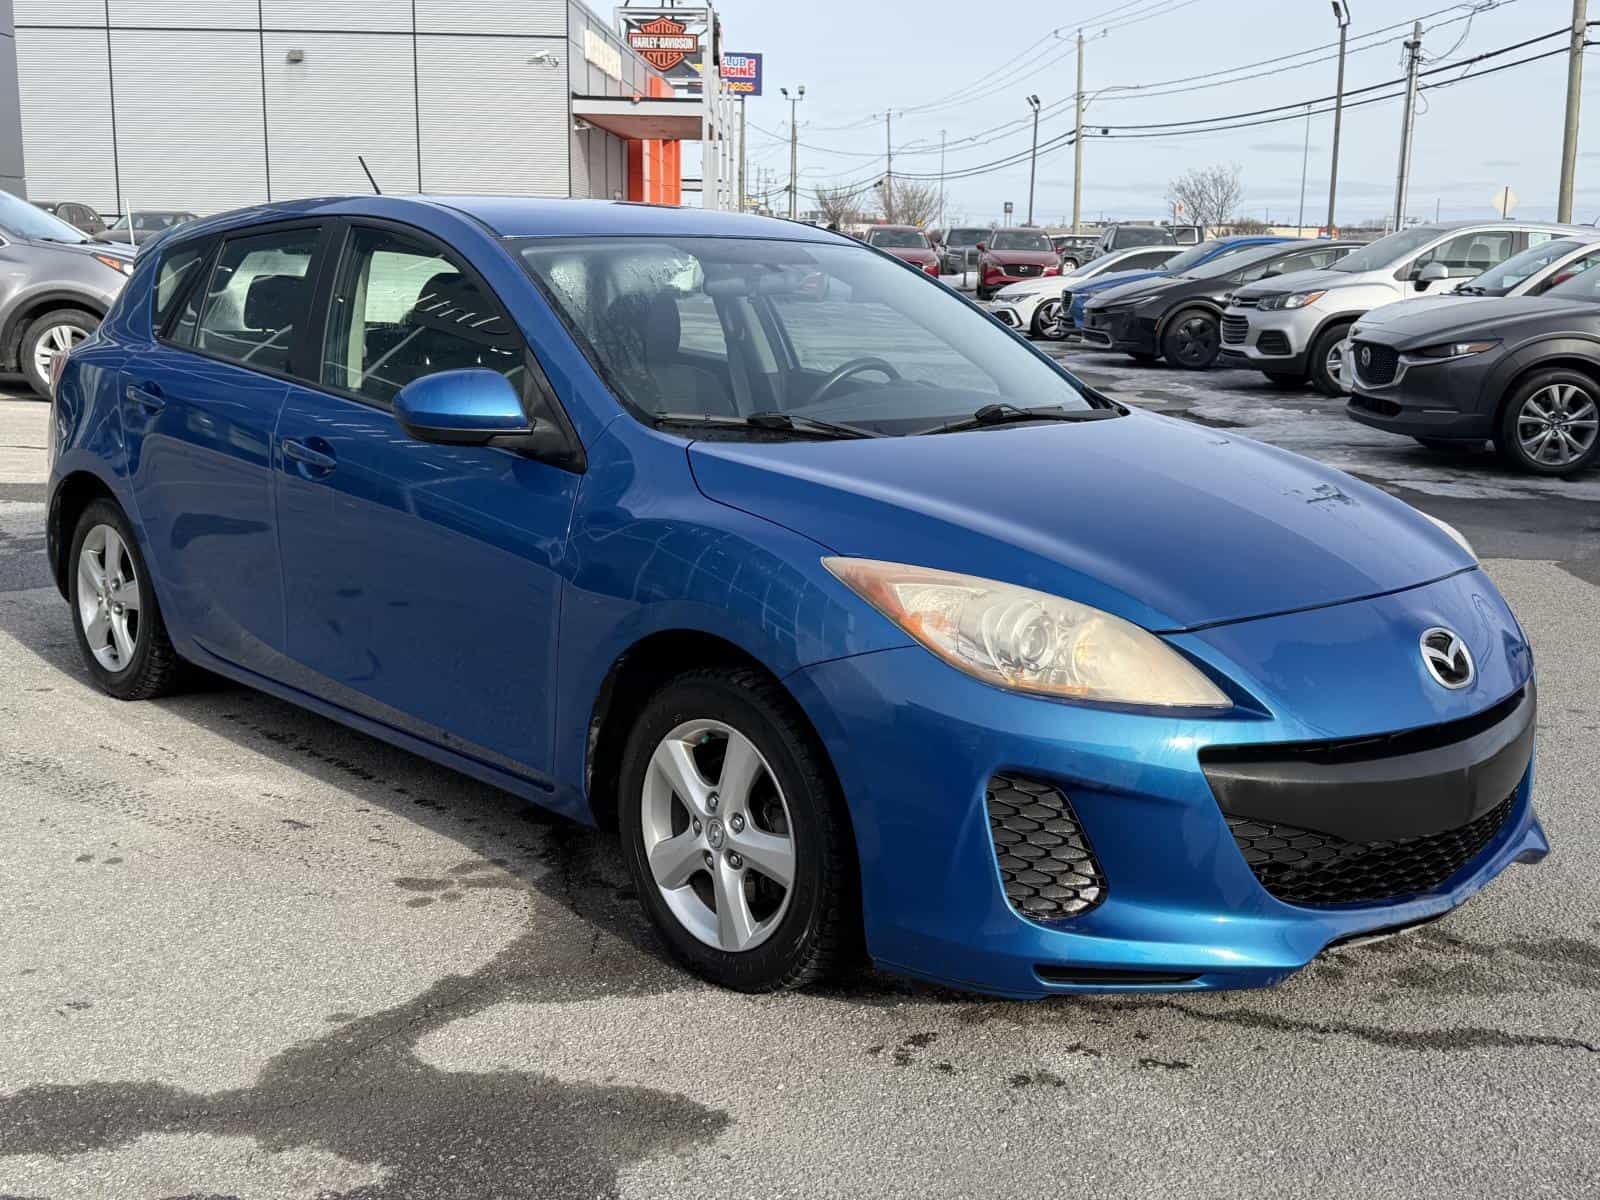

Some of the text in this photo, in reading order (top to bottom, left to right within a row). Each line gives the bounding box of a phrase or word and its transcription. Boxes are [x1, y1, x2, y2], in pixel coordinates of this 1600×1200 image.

[646, 23, 680, 34] MOTOR
[632, 36, 694, 49] HARLEY-DAVIDSON
[647, 51, 680, 66] CYCLES
